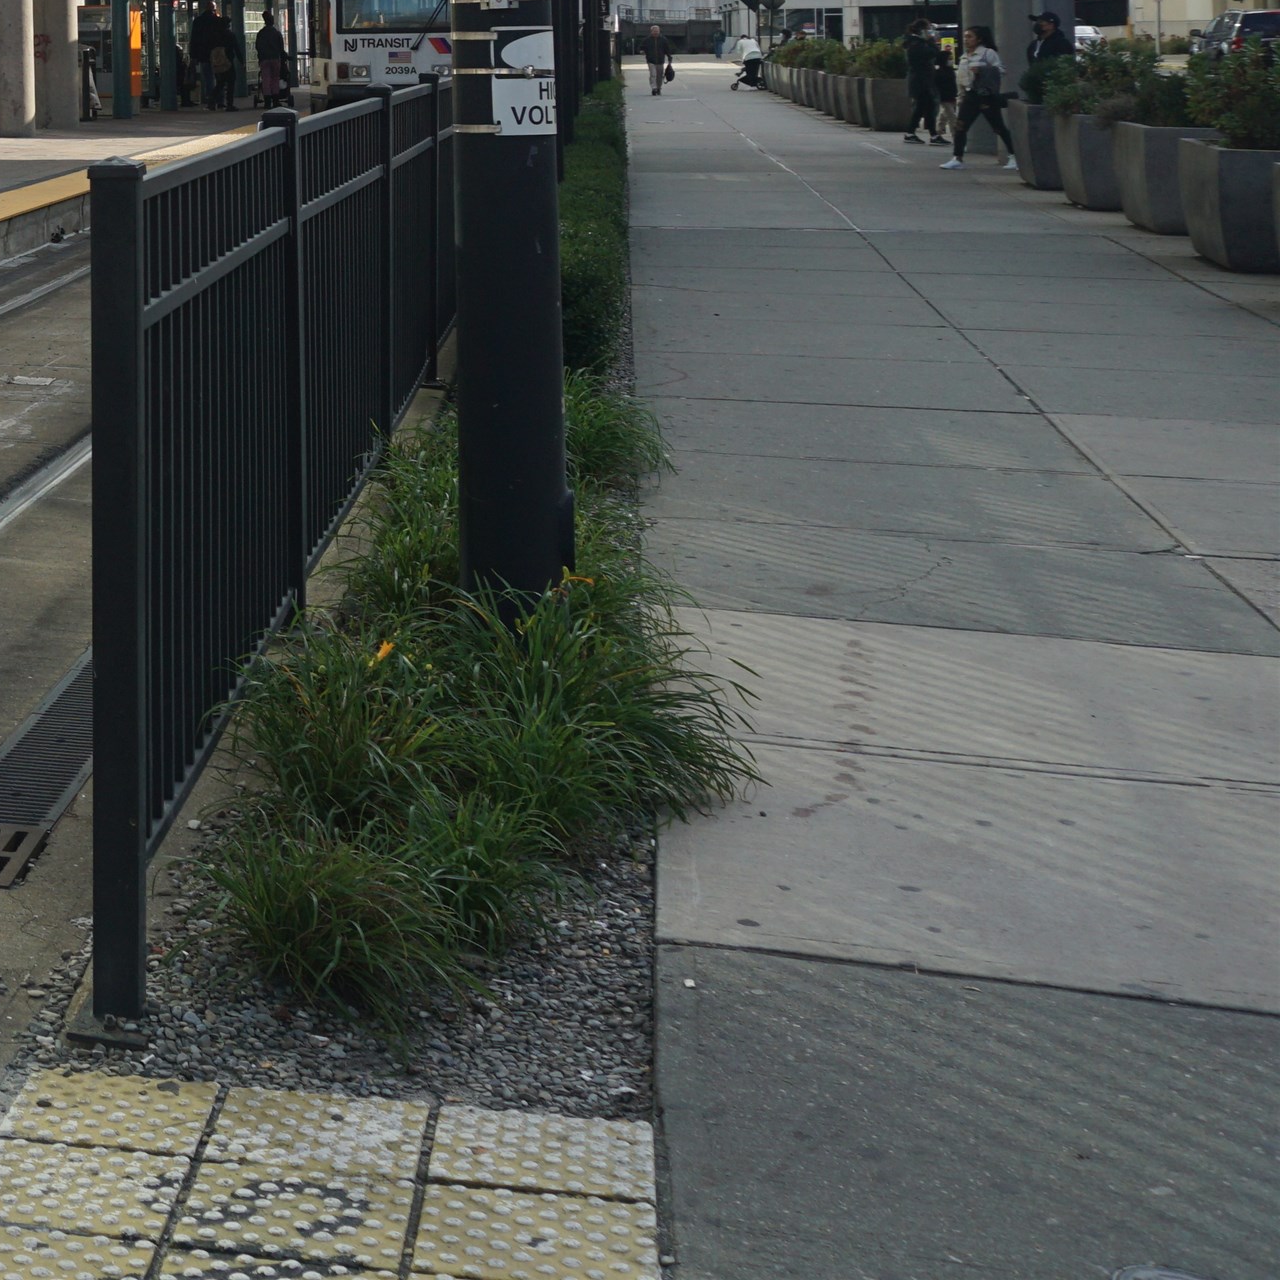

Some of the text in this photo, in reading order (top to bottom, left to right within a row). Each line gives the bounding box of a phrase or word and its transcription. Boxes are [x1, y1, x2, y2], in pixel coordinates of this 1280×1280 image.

[359, 38, 412, 49] TRANSIT
[385, 66, 417, 75] 2039A
[539, 81, 556, 101] HI
